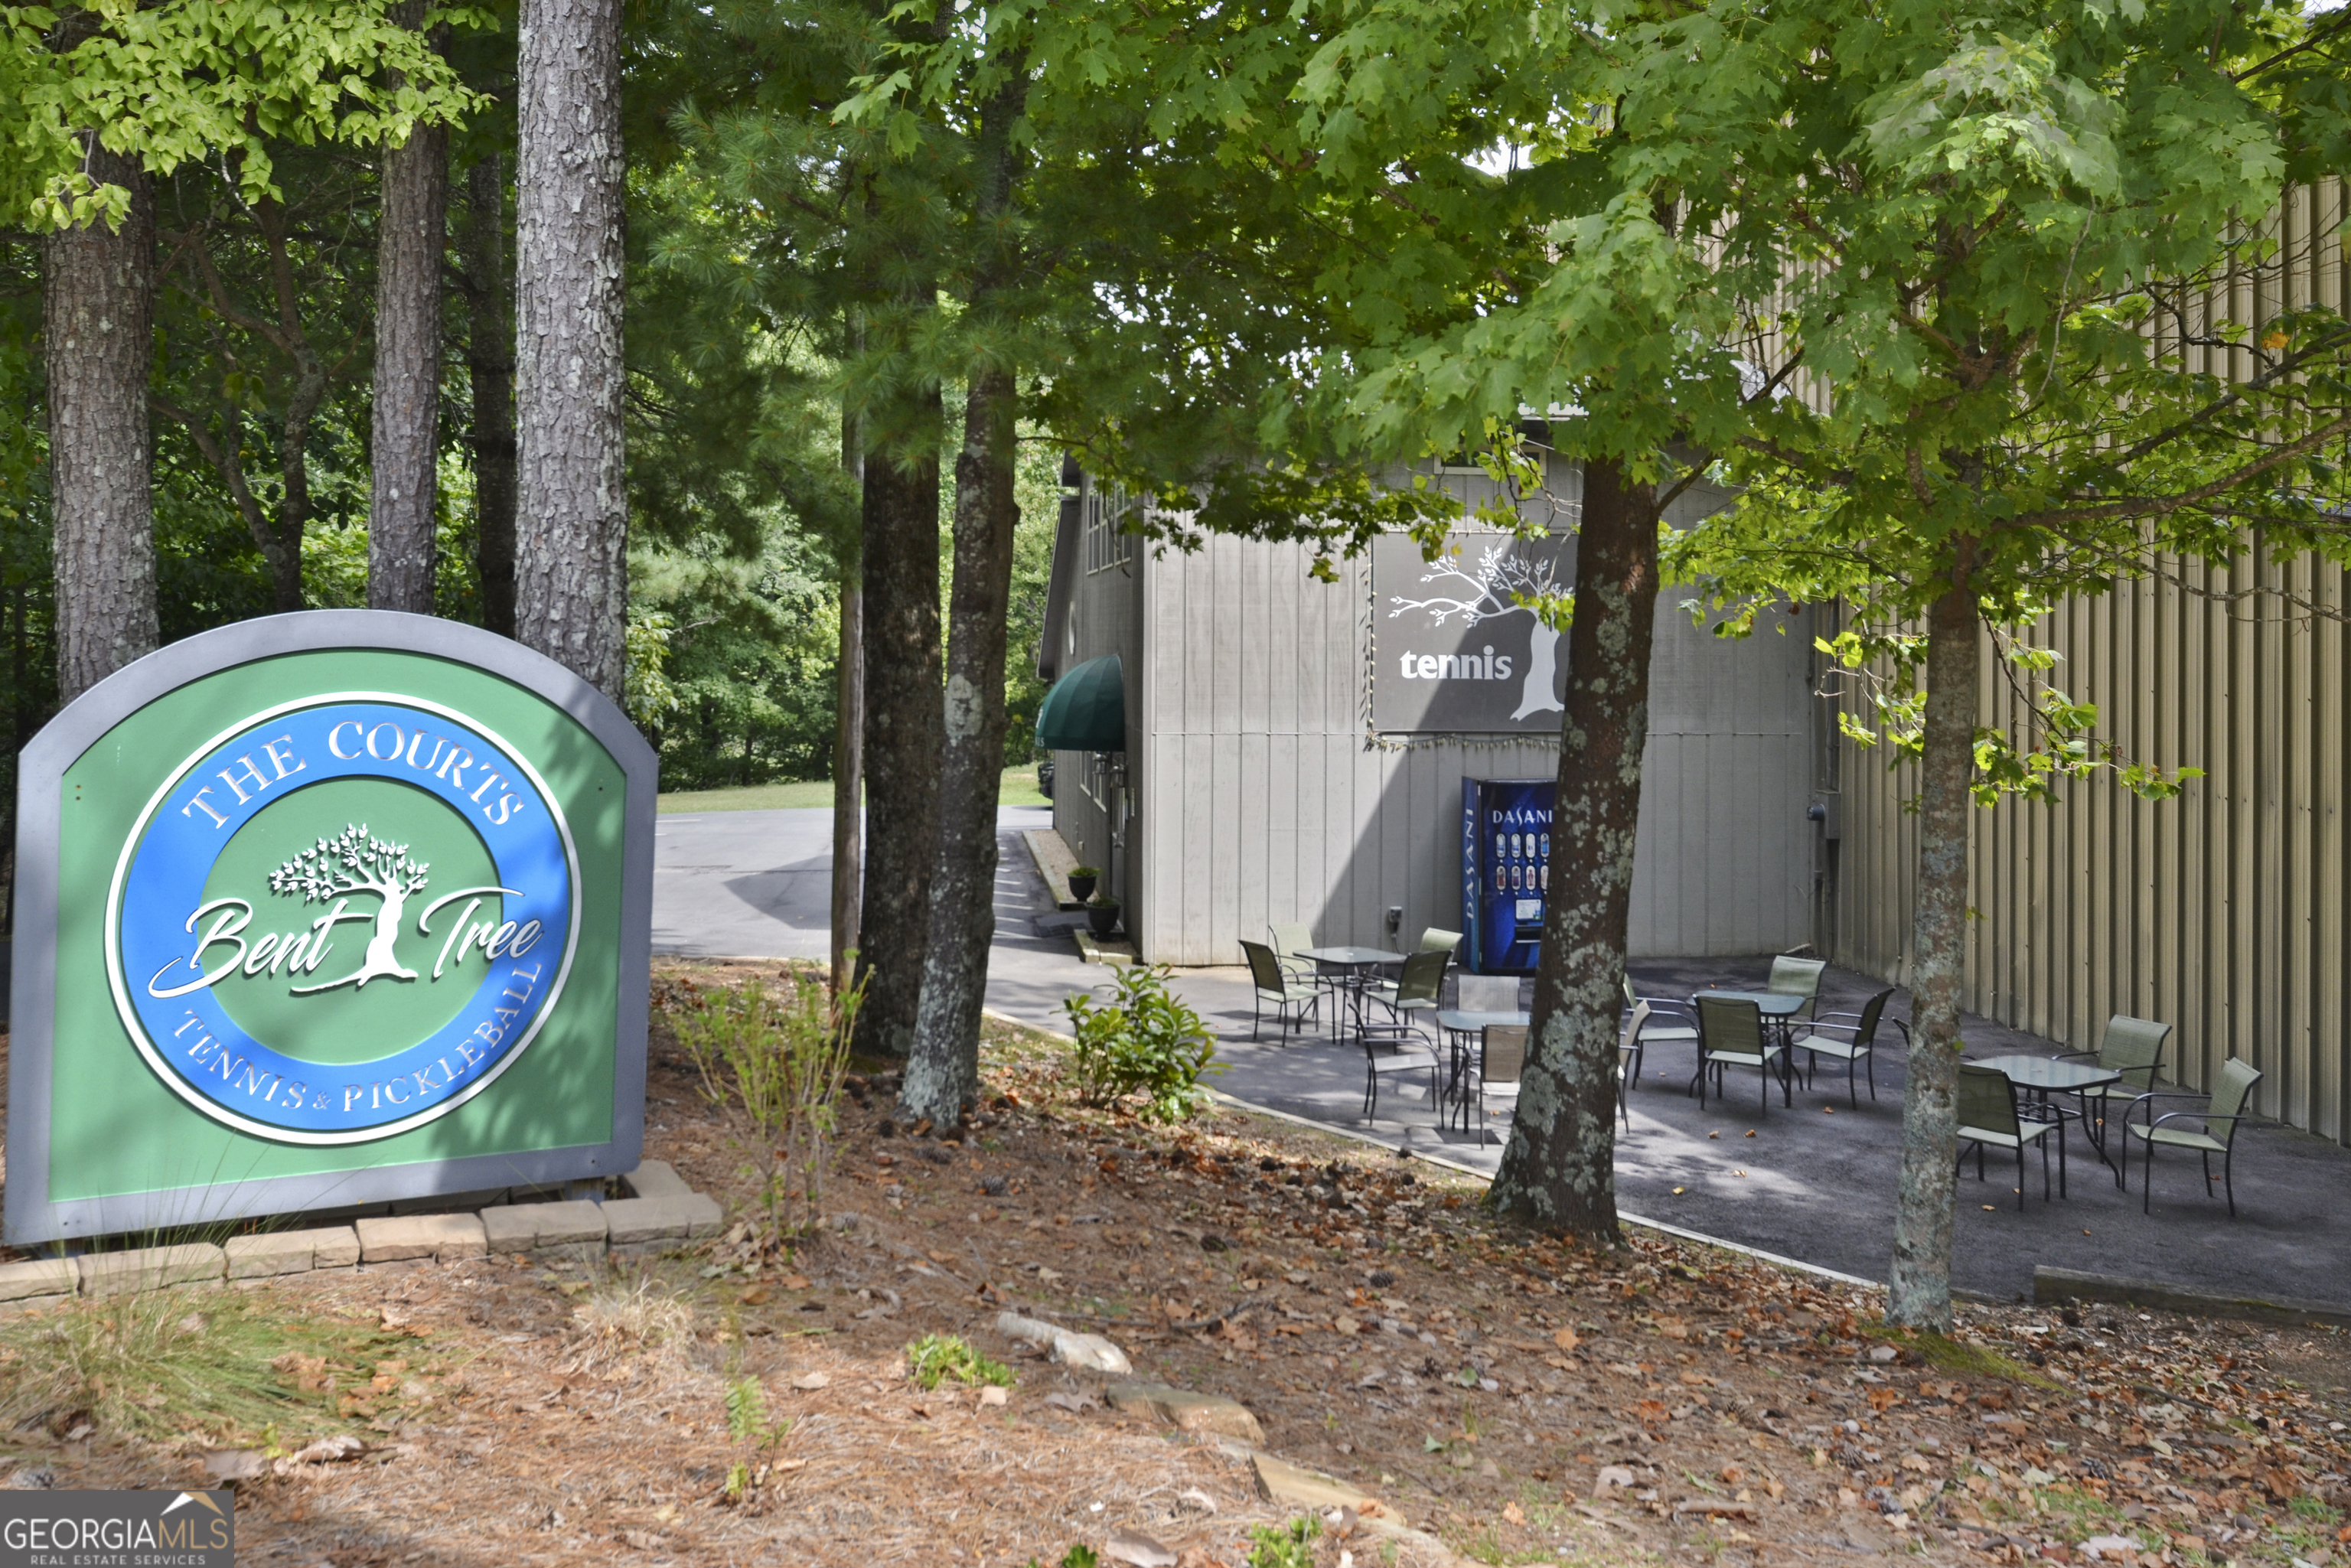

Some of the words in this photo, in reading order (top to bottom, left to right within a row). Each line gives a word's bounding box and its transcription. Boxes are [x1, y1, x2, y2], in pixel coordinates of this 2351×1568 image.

[1399, 645, 1512, 680] tennis
[181, 733, 306, 830] THE
[328, 720, 524, 826] COURTS
[1493, 807, 1552, 826] DASANI
[1465, 808, 1474, 919] DASANI
[148, 898, 373, 999] Bent
[419, 886, 544, 979] Tree
[172, 1008, 308, 1110] TENNIS
[312, 1090, 331, 1110] &
[343, 960, 543, 1112] PICKLEBALL
